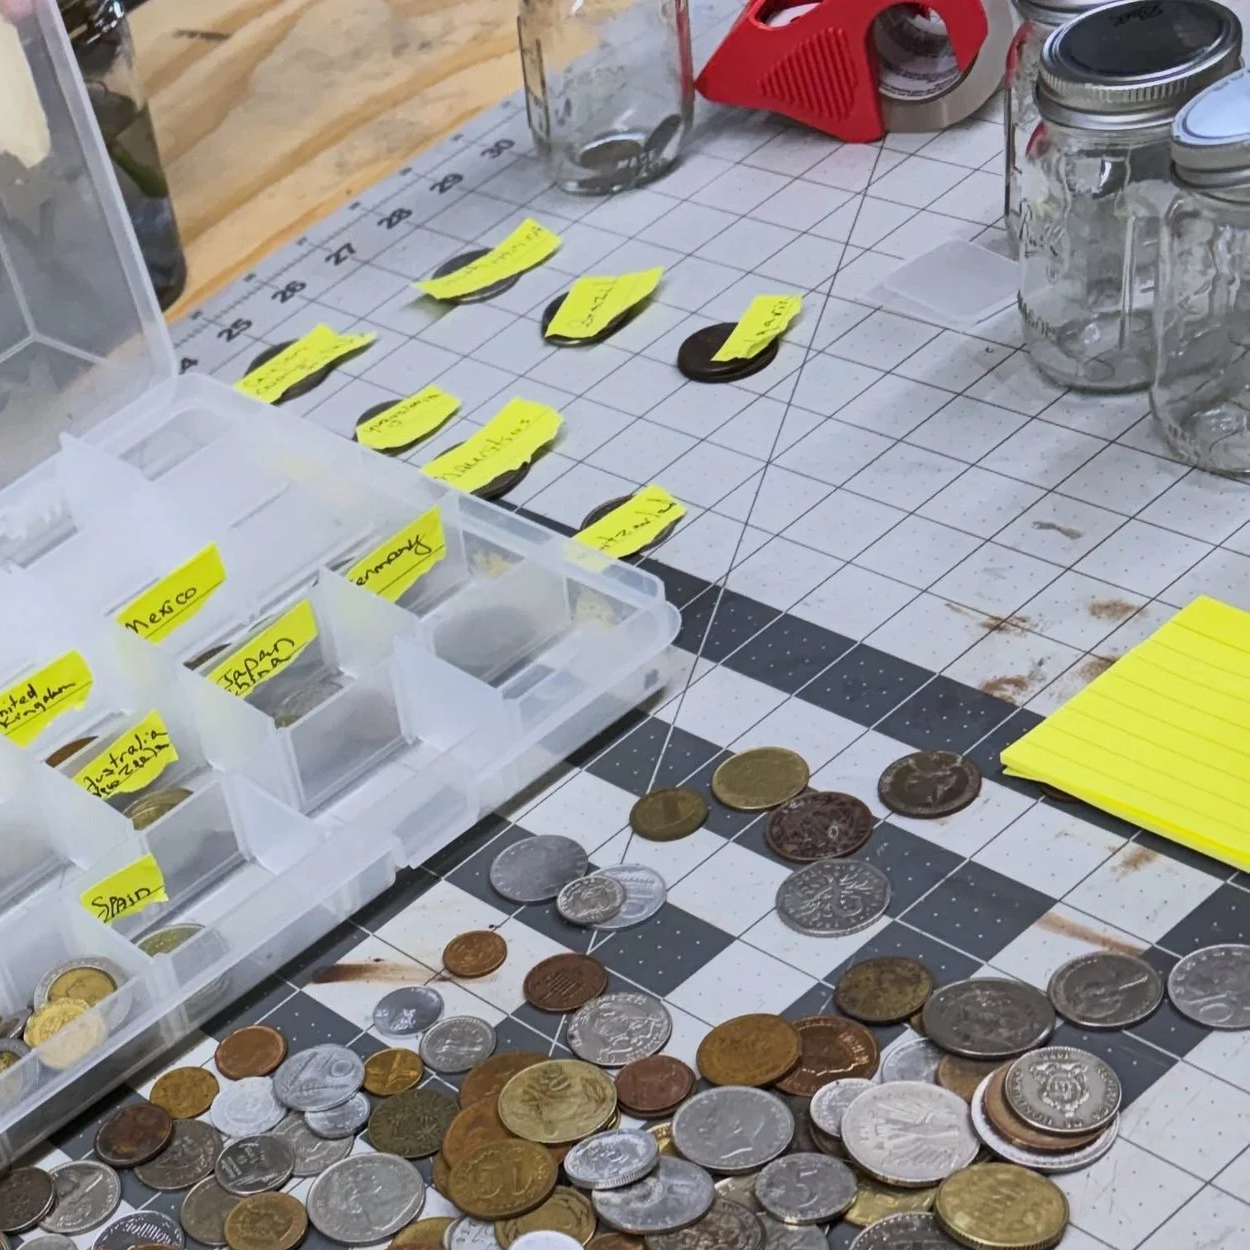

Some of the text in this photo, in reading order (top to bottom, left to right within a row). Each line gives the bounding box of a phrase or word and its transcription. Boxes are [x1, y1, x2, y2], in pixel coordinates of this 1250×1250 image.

[480, 139, 516, 159] 30
[430, 173, 463, 195] 29
[377, 207, 412, 230] 28
[325, 242, 358, 267] 27
[271, 280, 307, 303] 26
[217, 318, 253, 343] 25
[355, 534, 433, 588] ermany
[125, 586, 196, 635] Mexico
[217, 638, 295, 685] Japan
